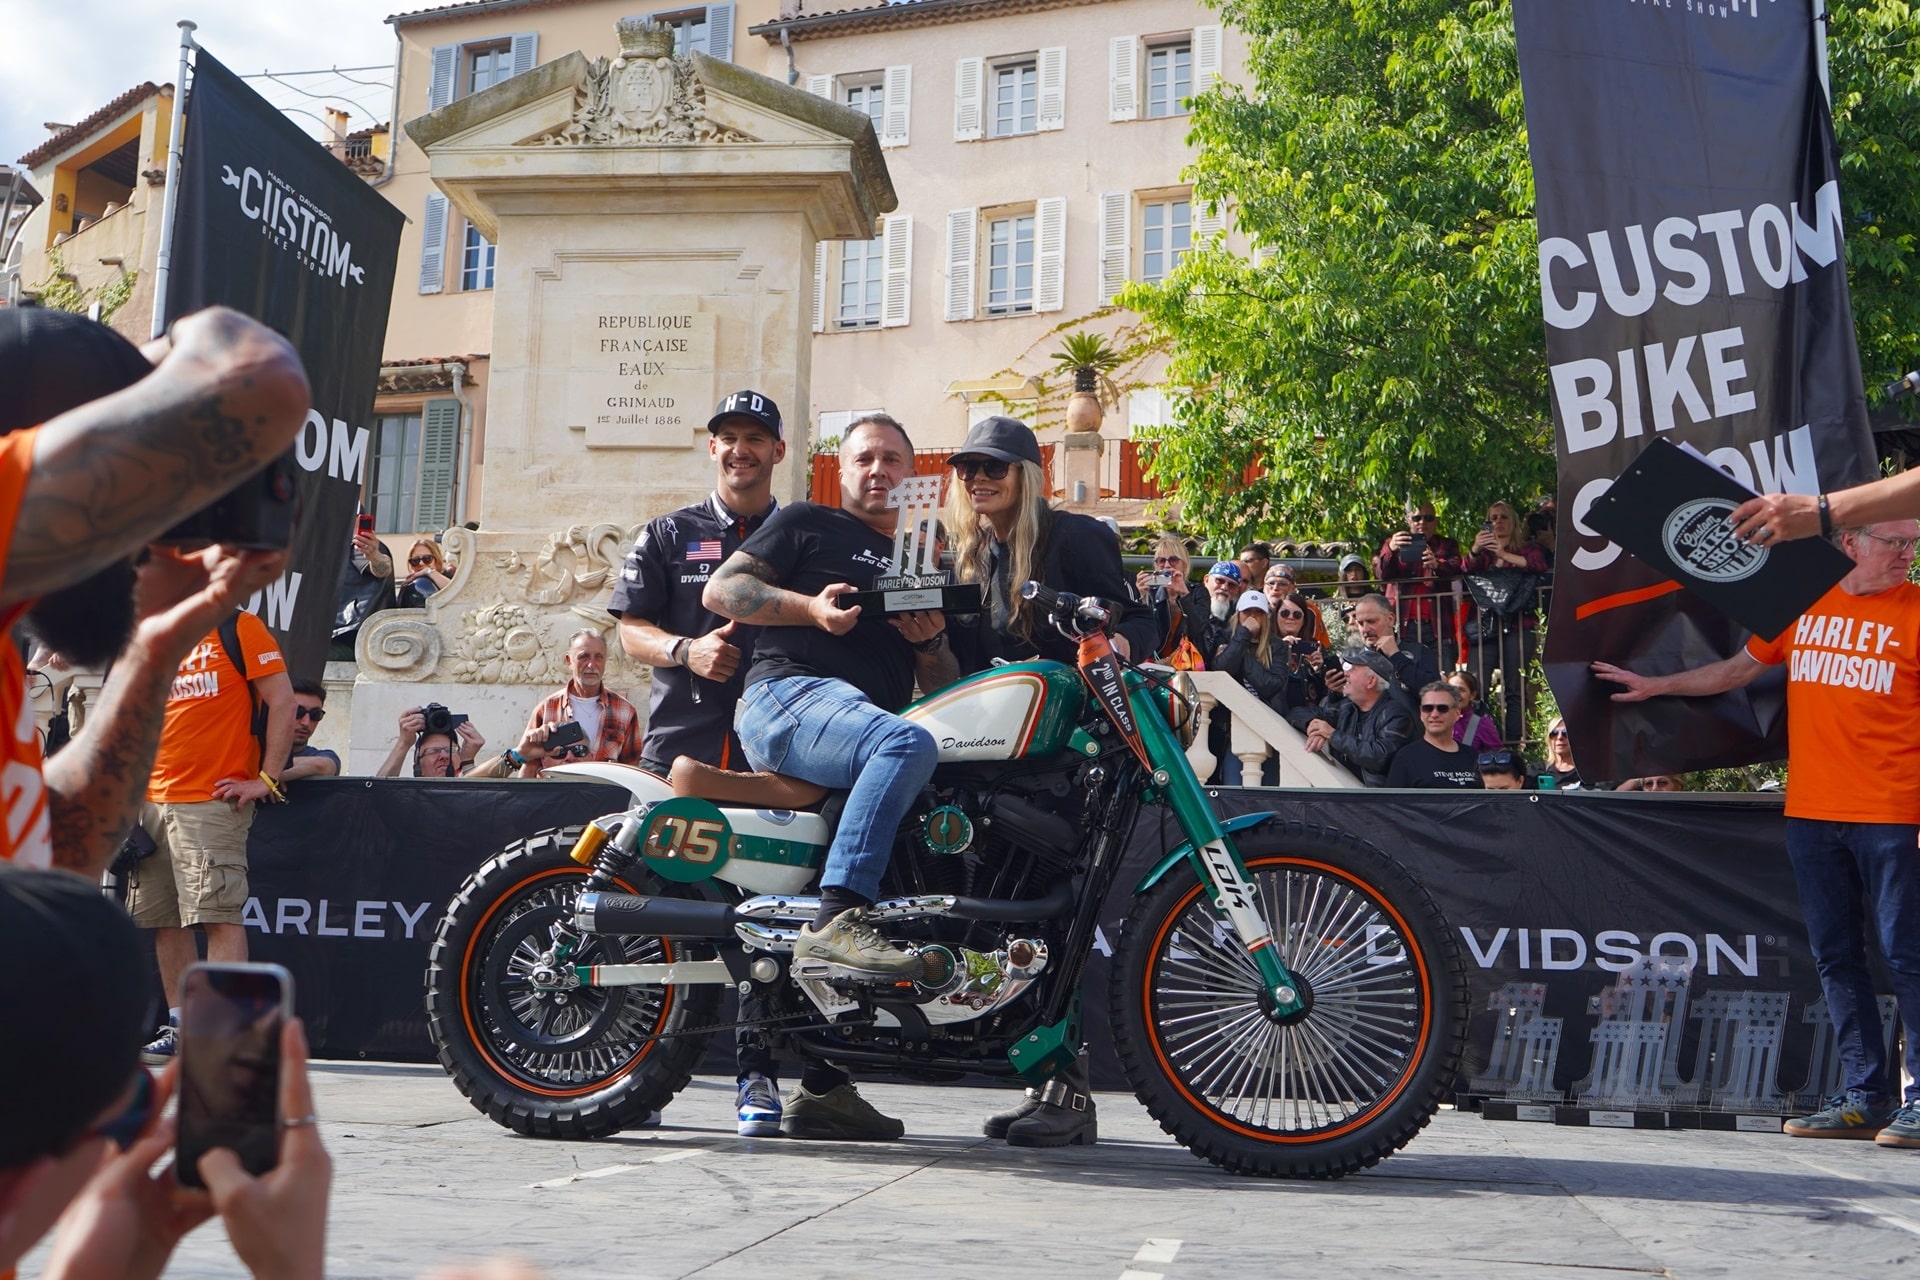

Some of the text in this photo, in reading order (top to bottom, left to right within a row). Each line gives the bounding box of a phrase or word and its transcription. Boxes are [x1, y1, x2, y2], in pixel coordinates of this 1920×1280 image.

[1686, 0, 1727, 18] SHOW
[240, 166, 351, 288] CUSTOM
[262, 225, 325, 277] BIKE SHOW
[1538, 180, 1844, 330] CUSTOM
[599, 315, 692, 330] REPUBLIQUE
[600, 339, 688, 356] FRANÇAISE
[619, 362, 665, 376] EAUX
[634, 379, 648, 390] de
[1550, 326, 1756, 454] BIKE
[607, 397, 675, 408] GRIMAUD
[724, 394, 764, 413] H-D
[597, 414, 681, 425] 1er Juillet 1886
[1681, 515, 1722, 548] Custom
[851, 554, 875, 565] Lord
[1702, 537, 1740, 569] SHO
[1794, 614, 1900, 654] HARLEY-
[1091, 663, 1115, 681] 2ND
[1791, 649, 1896, 695] DAVIDSON
[1101, 681, 1117, 697] IN
[1110, 696, 1132, 732] CLASS
[942, 736, 1007, 750] Davidson
[644, 814, 727, 864] 05
[242, 896, 432, 940] ARLEY
